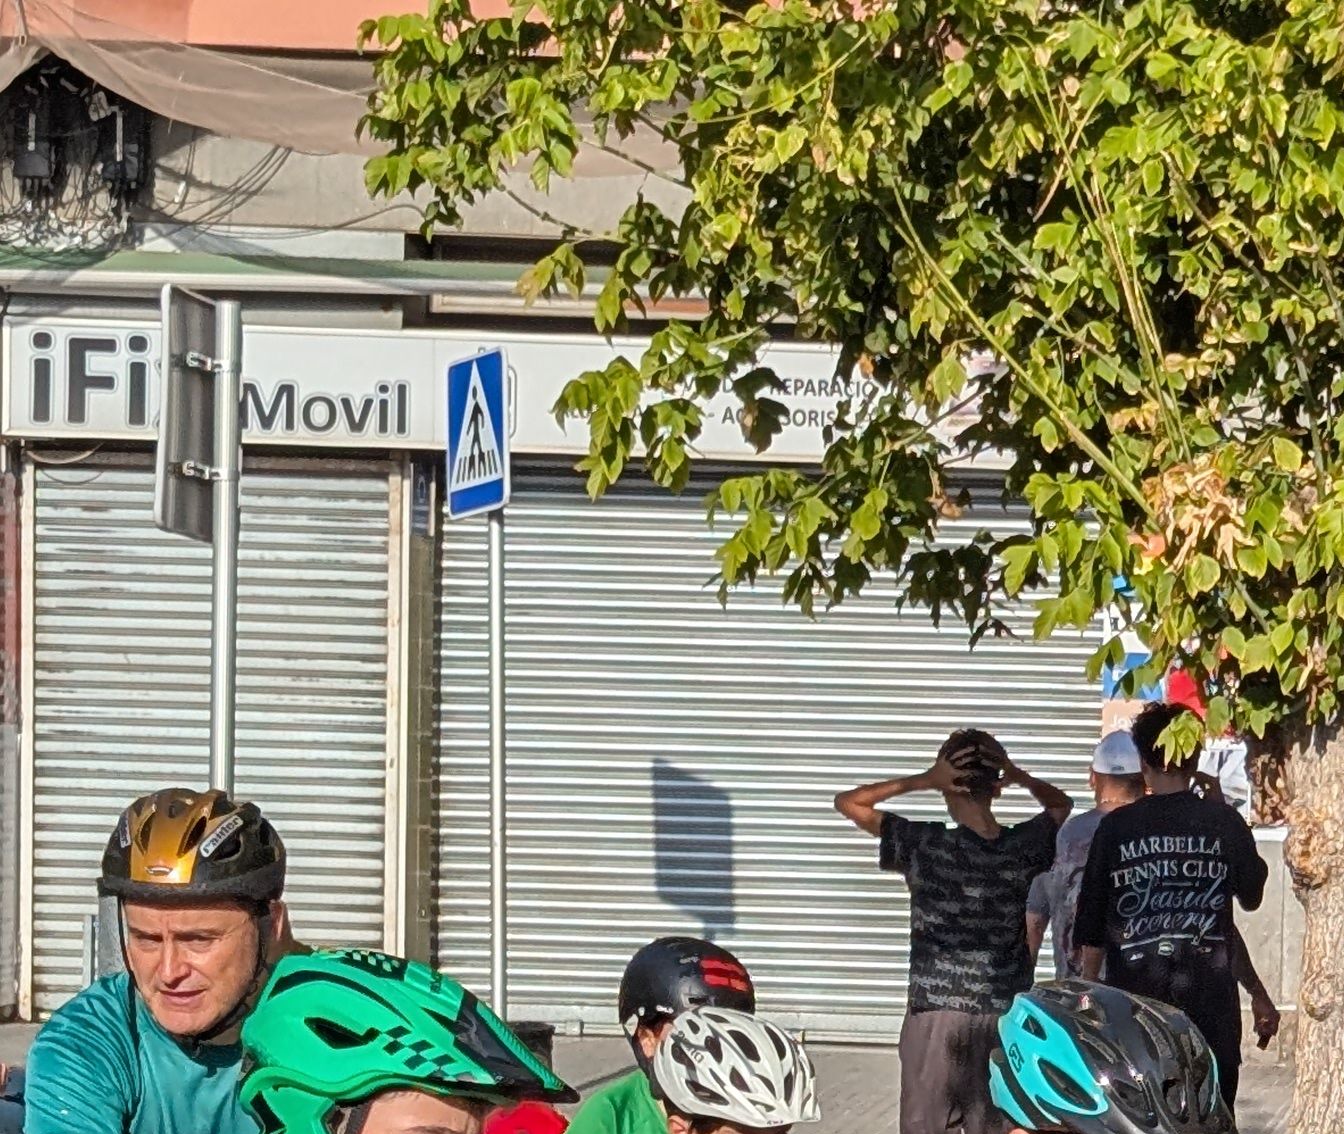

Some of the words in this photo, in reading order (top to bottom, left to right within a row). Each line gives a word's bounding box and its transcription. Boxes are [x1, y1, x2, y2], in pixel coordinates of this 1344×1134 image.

[241, 381, 408, 434] Movil
[1118, 835, 1221, 862] MARBELLA
[1110, 859, 1178, 888] TENNIS
